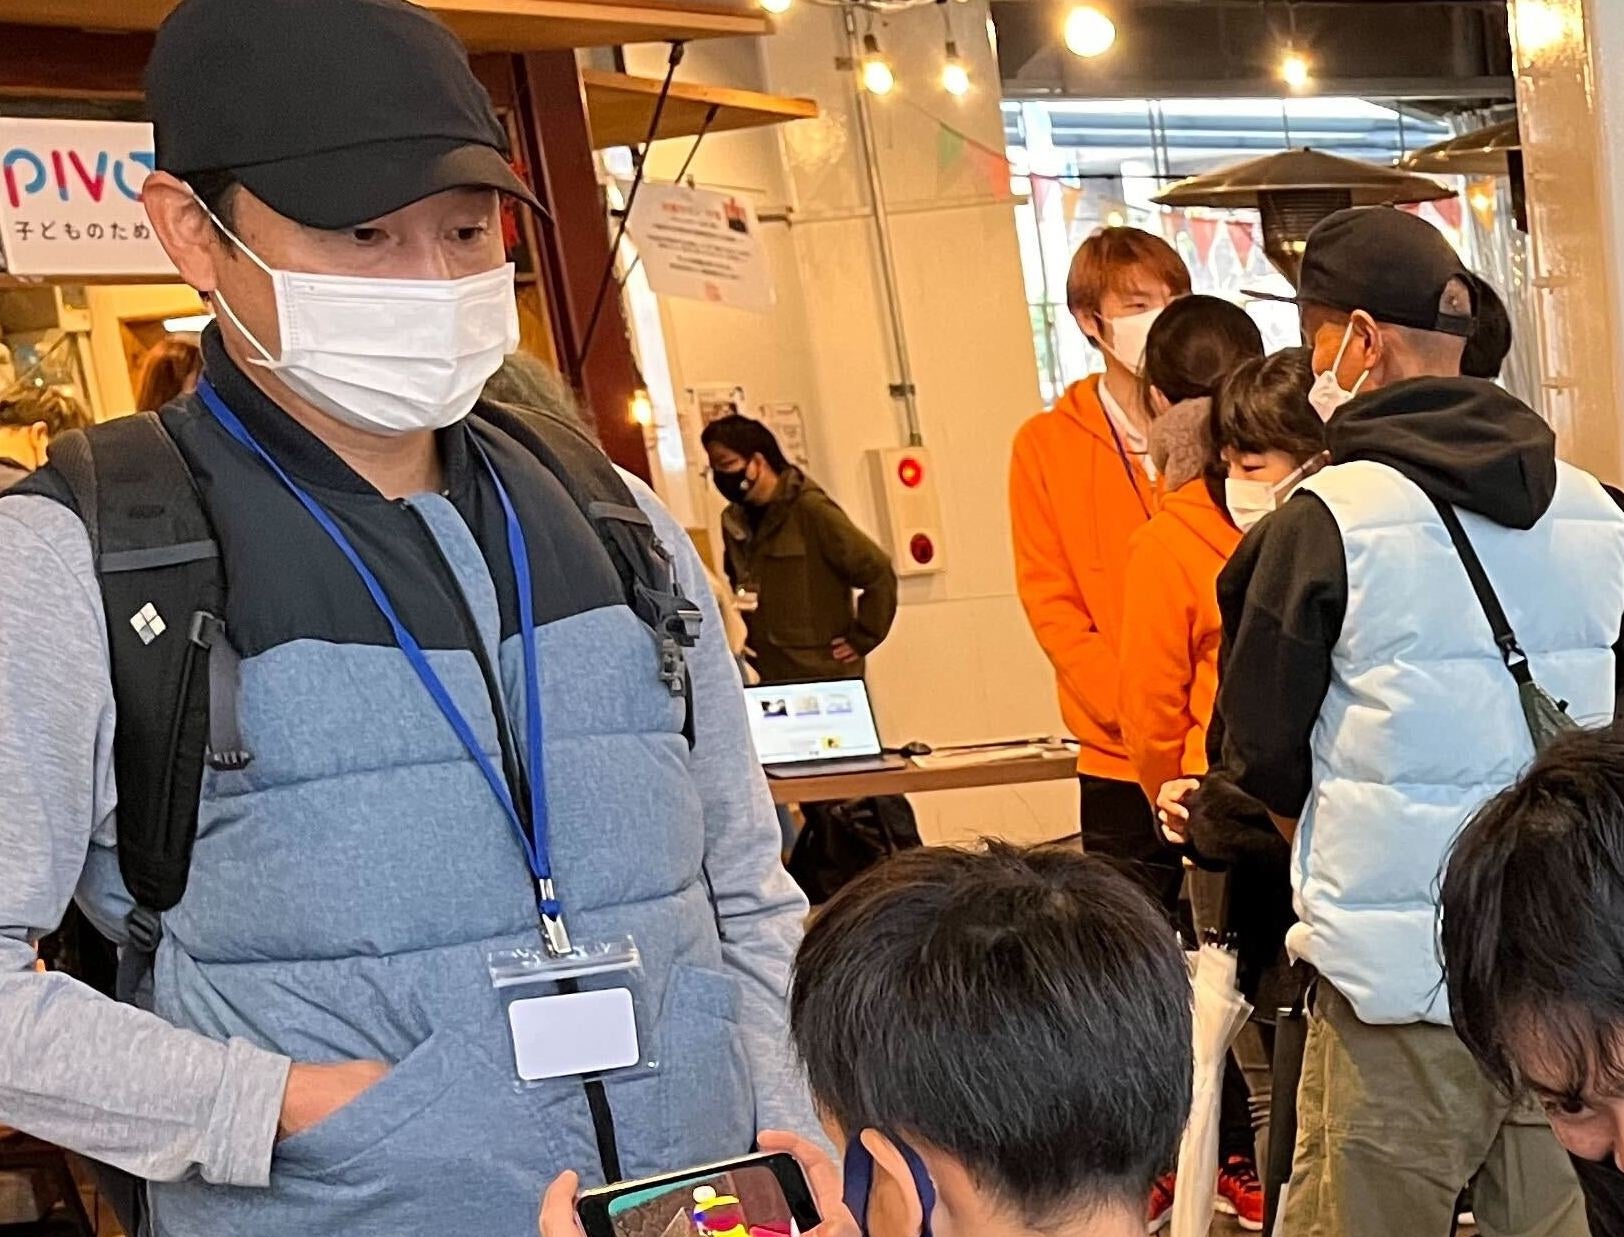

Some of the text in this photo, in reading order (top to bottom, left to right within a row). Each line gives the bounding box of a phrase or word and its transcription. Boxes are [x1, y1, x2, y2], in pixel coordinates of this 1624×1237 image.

[15, 221, 150, 241] 子どものため
